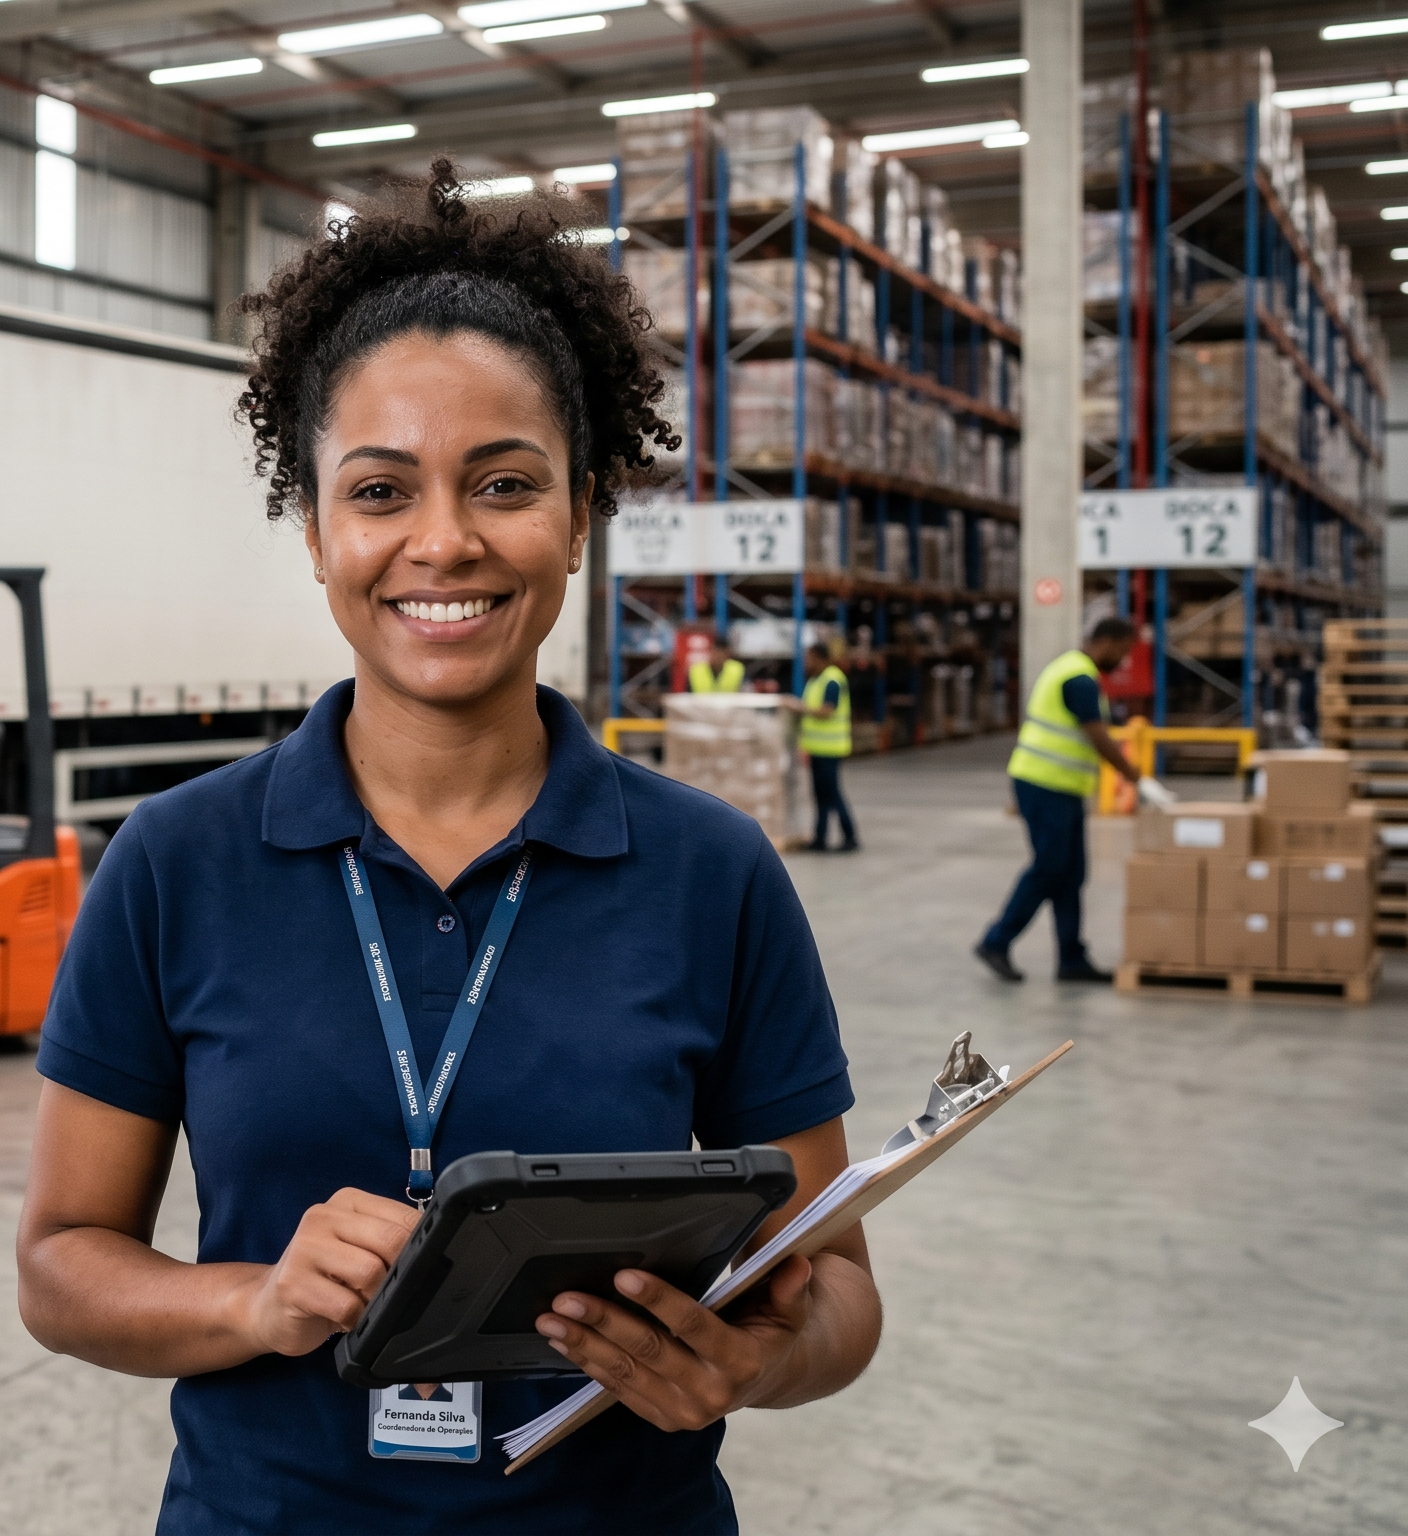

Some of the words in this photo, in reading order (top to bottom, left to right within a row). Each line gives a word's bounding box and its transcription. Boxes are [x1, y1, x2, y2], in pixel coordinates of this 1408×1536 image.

[1165, 500, 1241, 522] DOCA
[736, 533, 776, 562] 12
[1178, 524, 1228, 557] 12
[384, 1408, 436, 1422] Fernanda
[438, 1411, 465, 1423] Silva
[426, 1425, 436, 1433] de
